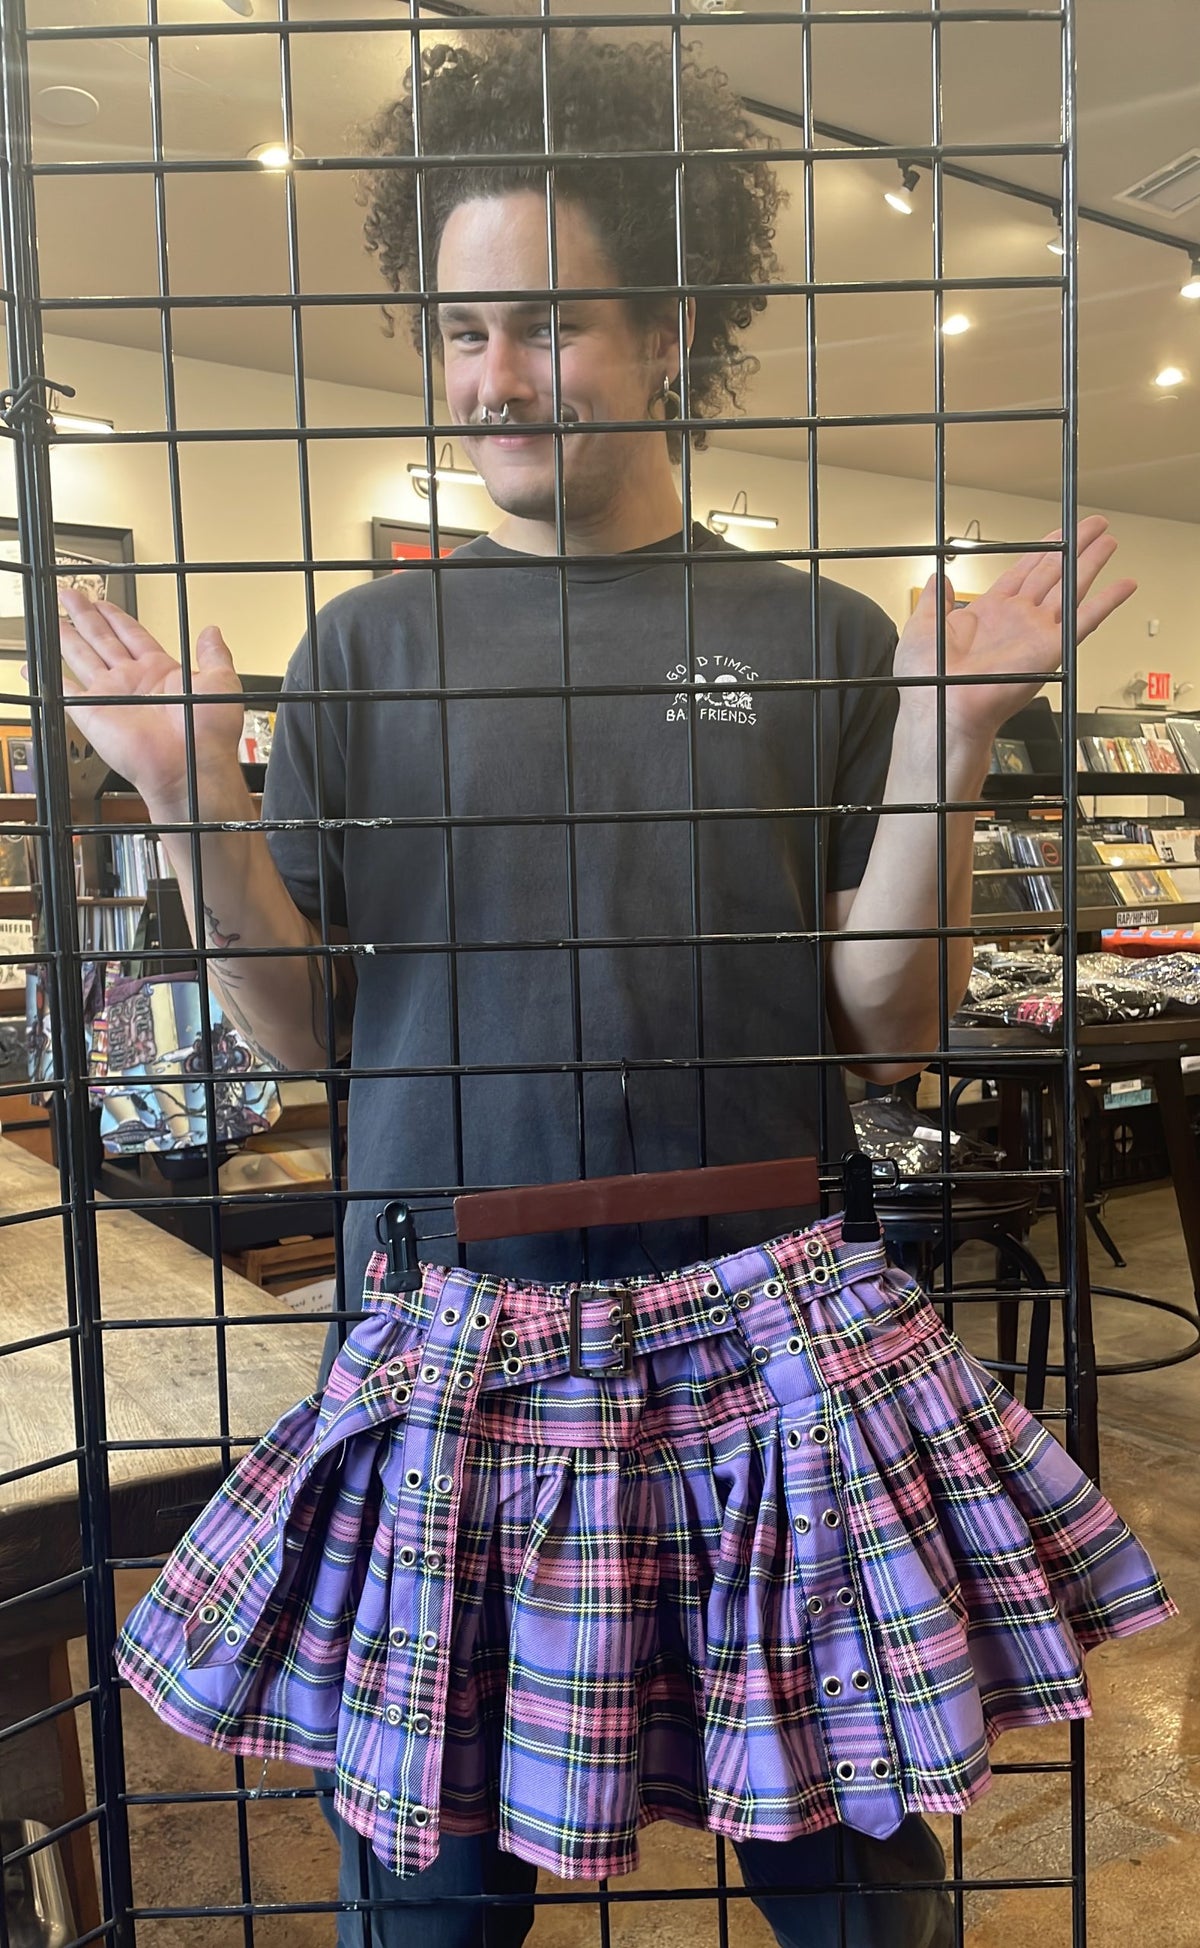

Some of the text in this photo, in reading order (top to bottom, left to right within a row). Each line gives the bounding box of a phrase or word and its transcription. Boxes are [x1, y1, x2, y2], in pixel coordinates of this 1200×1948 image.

[666, 655, 759, 682] GOD TIMES
[1148, 672, 1171, 700] EXIT
[666, 708, 757, 726] BA FRIENDS
[1117, 910, 1158, 926] RAP/HIP-HOP
